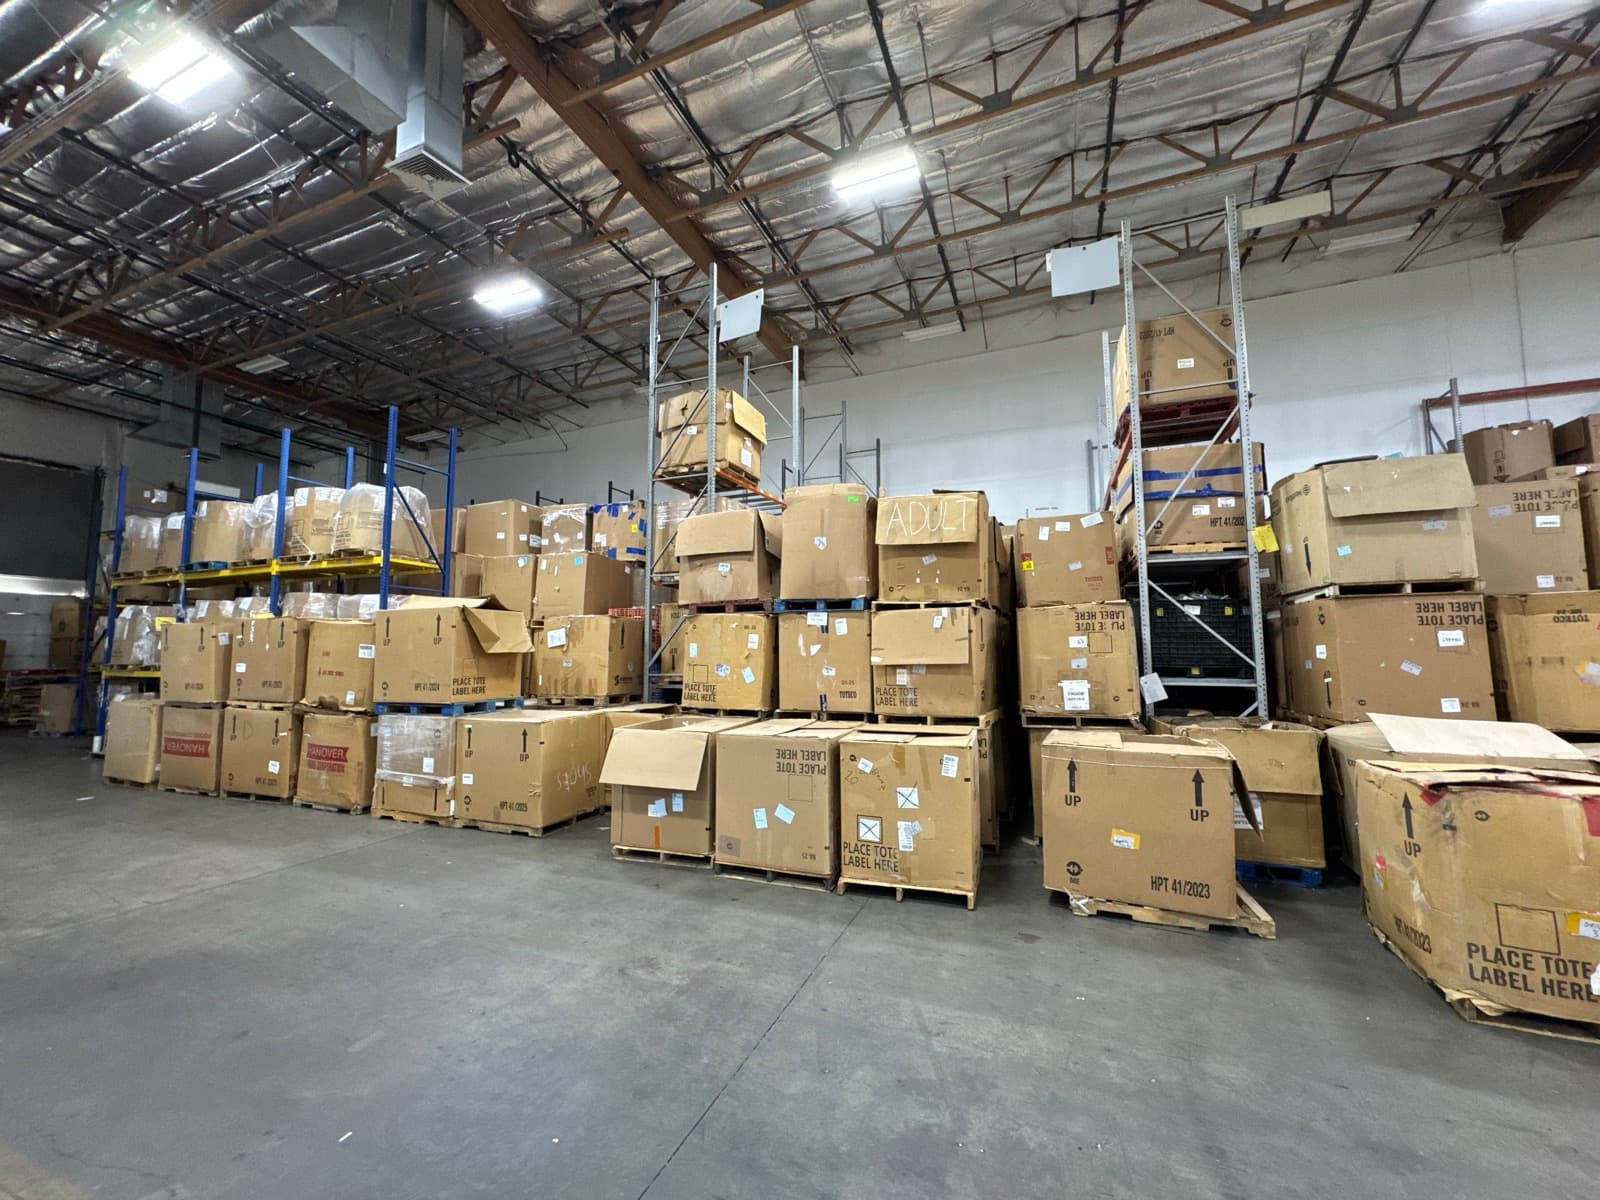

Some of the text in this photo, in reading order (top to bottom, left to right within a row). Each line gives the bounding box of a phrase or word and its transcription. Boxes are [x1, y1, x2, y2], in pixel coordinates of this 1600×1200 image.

[1512, 490, 1541, 501] HERE
[1515, 501, 1541, 512] TOTE
[886, 498, 977, 537] ADULT
[1416, 601, 1482, 613] LABEL HERE
[1074, 610, 1125, 621] LABEL HERE
[1418, 614, 1484, 626] PLACE TOTE
[452, 676, 486, 686] PLACE TOTE
[452, 686, 486, 696] LABEL HERE
[684, 684, 701, 692] PLACE
[876, 688, 918, 696] PLACE TOTE
[684, 692, 716, 702] LABEL HERE
[876, 698, 918, 707] LABEL HERE
[309, 746, 344, 758] HANOVER
[465, 750, 473, 758] UP
[520, 754, 529, 762] UP
[776, 748, 826, 761] LABEL HERE
[776, 762, 826, 775] PLACE TOTE
[1064, 794, 1081, 807] UP
[1190, 809, 1209, 822] UP
[843, 841, 899, 859] PLACE TOTE
[1404, 840, 1422, 858] UP
[843, 857, 899, 872] LABEL HERE
[1151, 876, 1210, 899] HPT 41/2023
[1466, 942, 1592, 978] PLACE TOTE
[1467, 964, 1599, 1003] LABEL HERE
